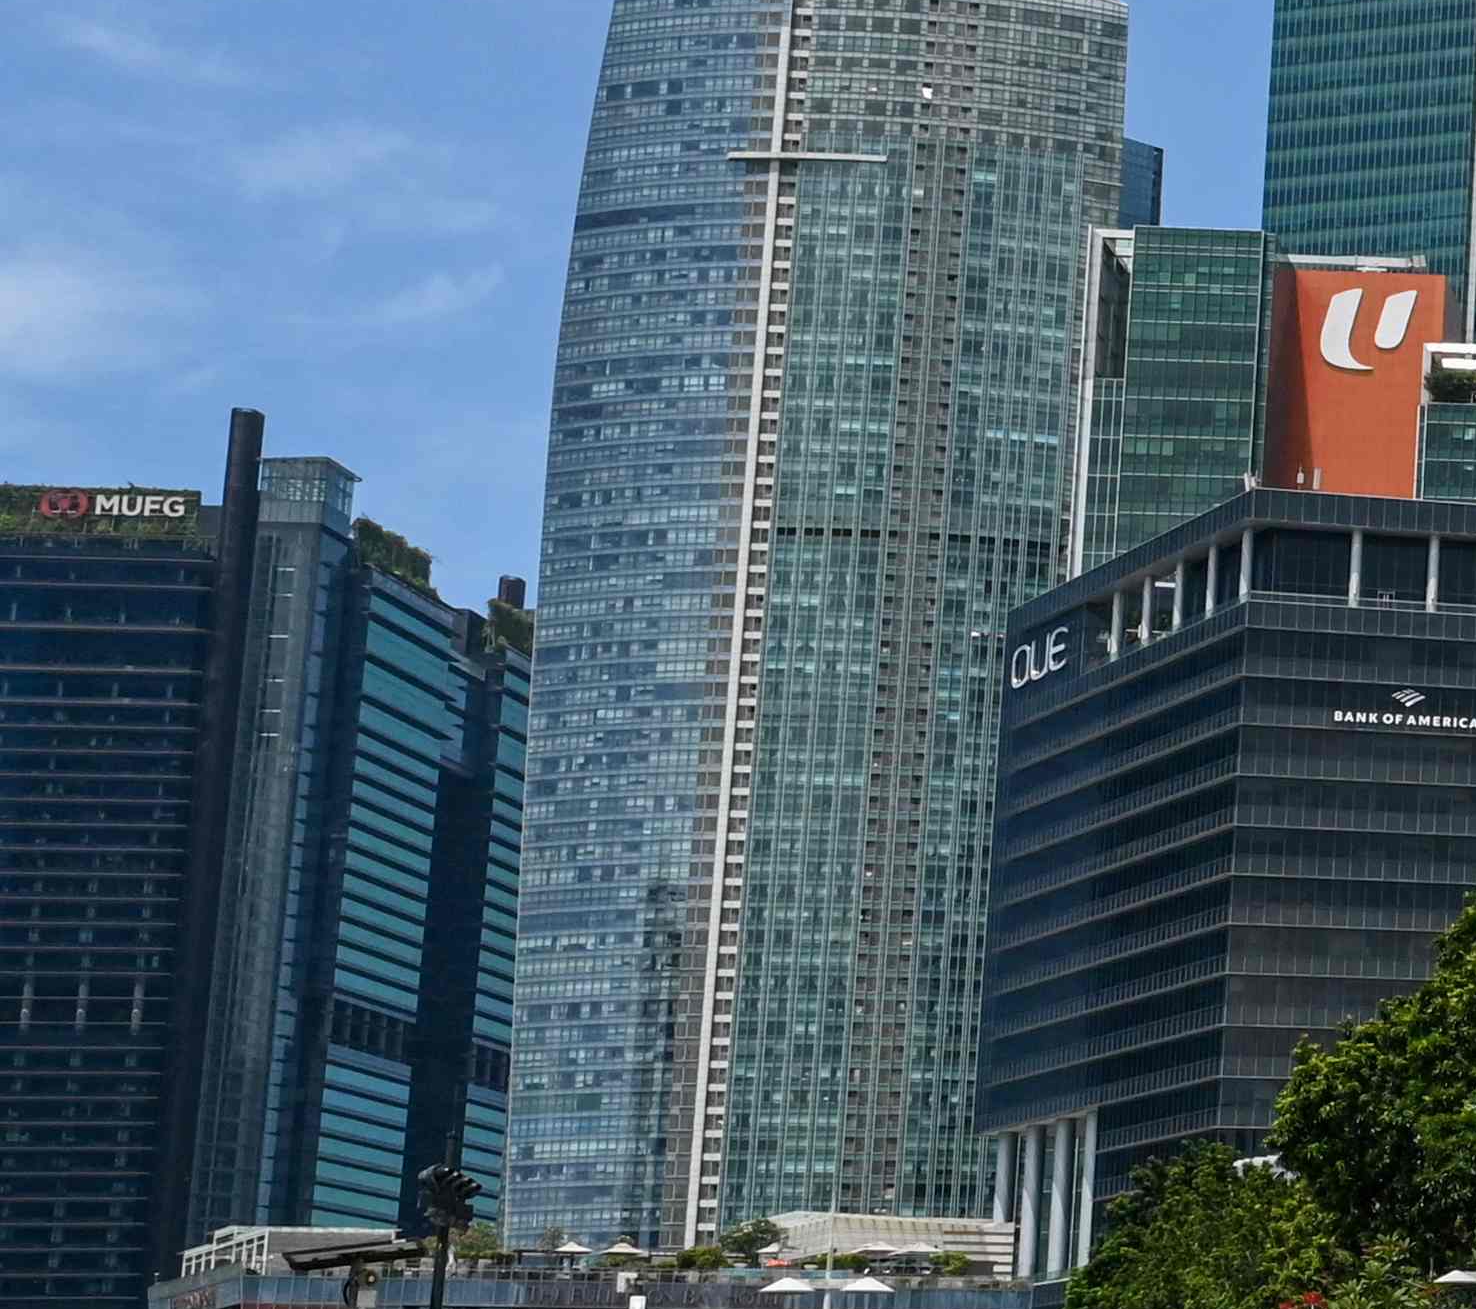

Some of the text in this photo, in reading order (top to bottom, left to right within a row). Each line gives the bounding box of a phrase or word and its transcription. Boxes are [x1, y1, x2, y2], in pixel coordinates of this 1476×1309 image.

[94, 494, 185, 518] MUFG
[1010, 626, 1070, 690] OUE
[1333, 709, 1379, 724] BANK
[1382, 712, 1404, 726] OF
